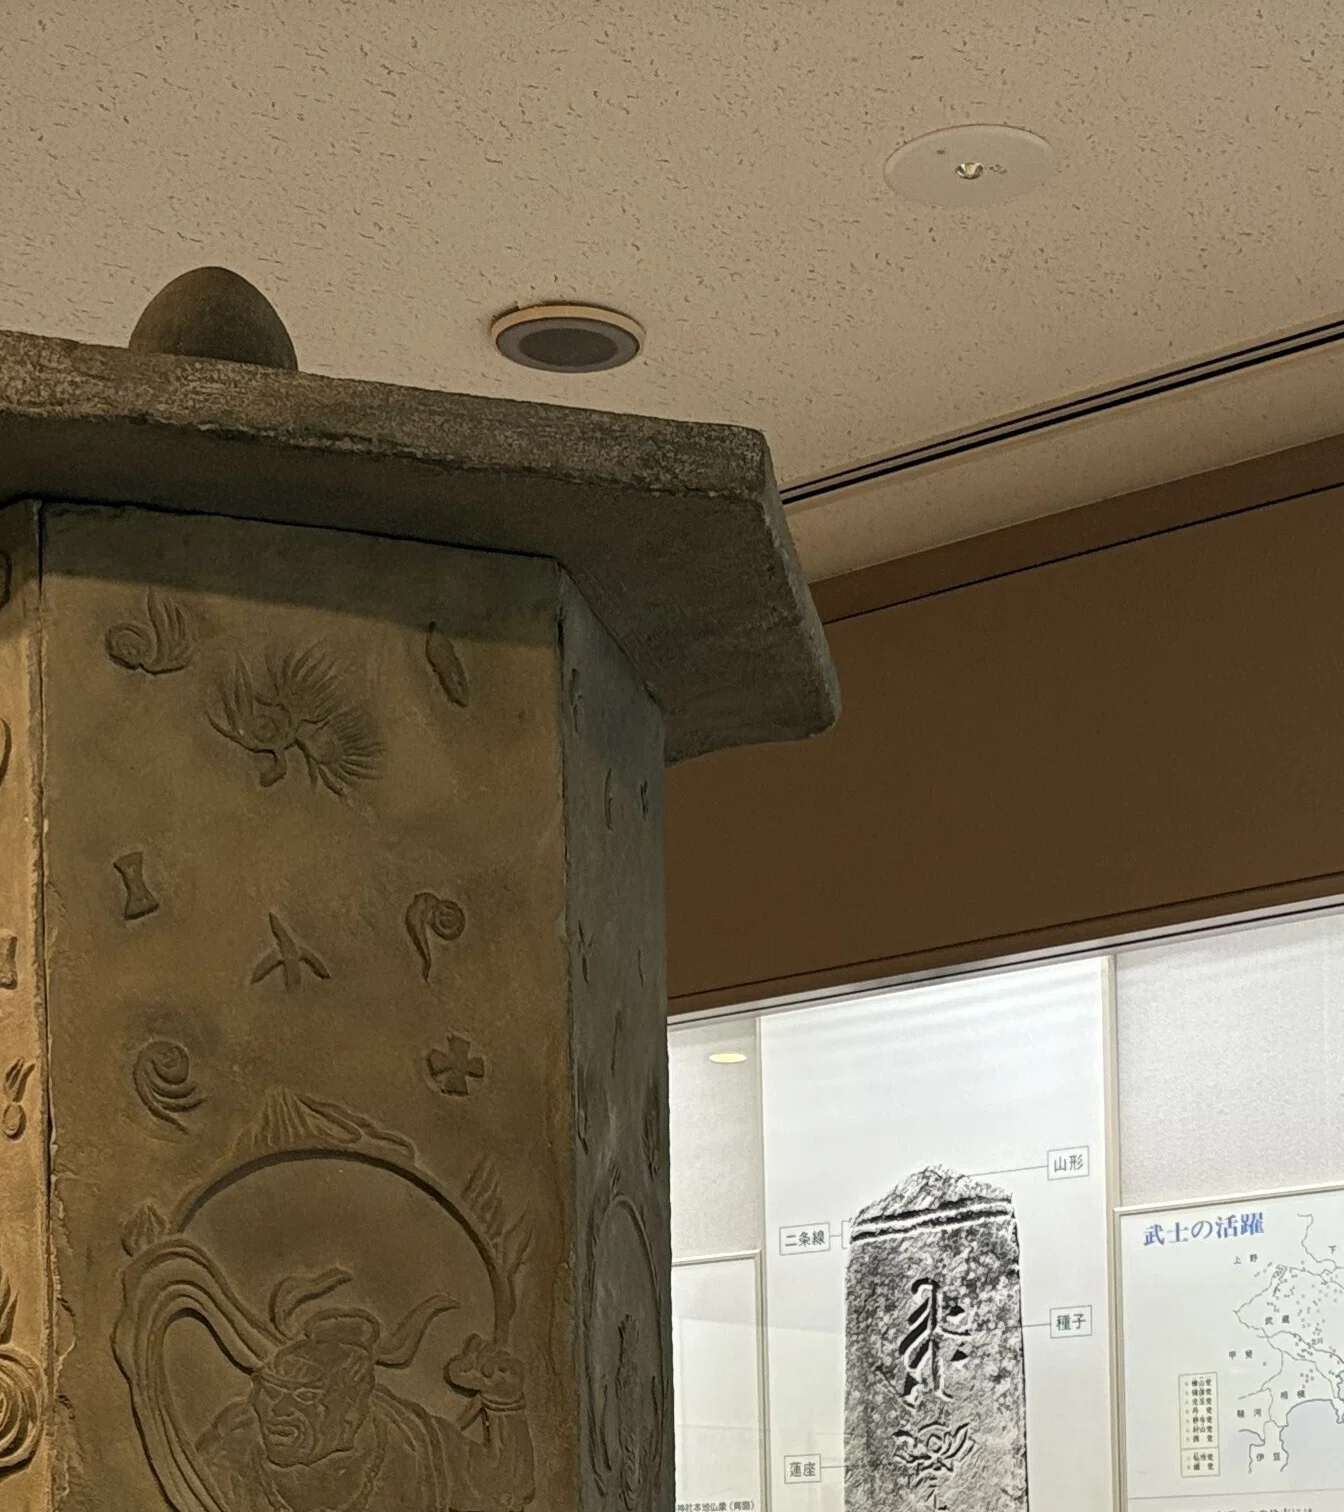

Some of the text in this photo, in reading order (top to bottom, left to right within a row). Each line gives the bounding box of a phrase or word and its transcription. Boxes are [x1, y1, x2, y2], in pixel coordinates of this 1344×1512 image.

[1054, 1154, 1084, 1174] 山形
[784, 1229, 826, 1249] 二条線
[1143, 1212, 1264, 1247] 武士の活躍
[1234, 1253, 1258, 1265] 上野
[1056, 1312, 1086, 1331] 種子
[789, 1459, 817, 1477] 蓮座
